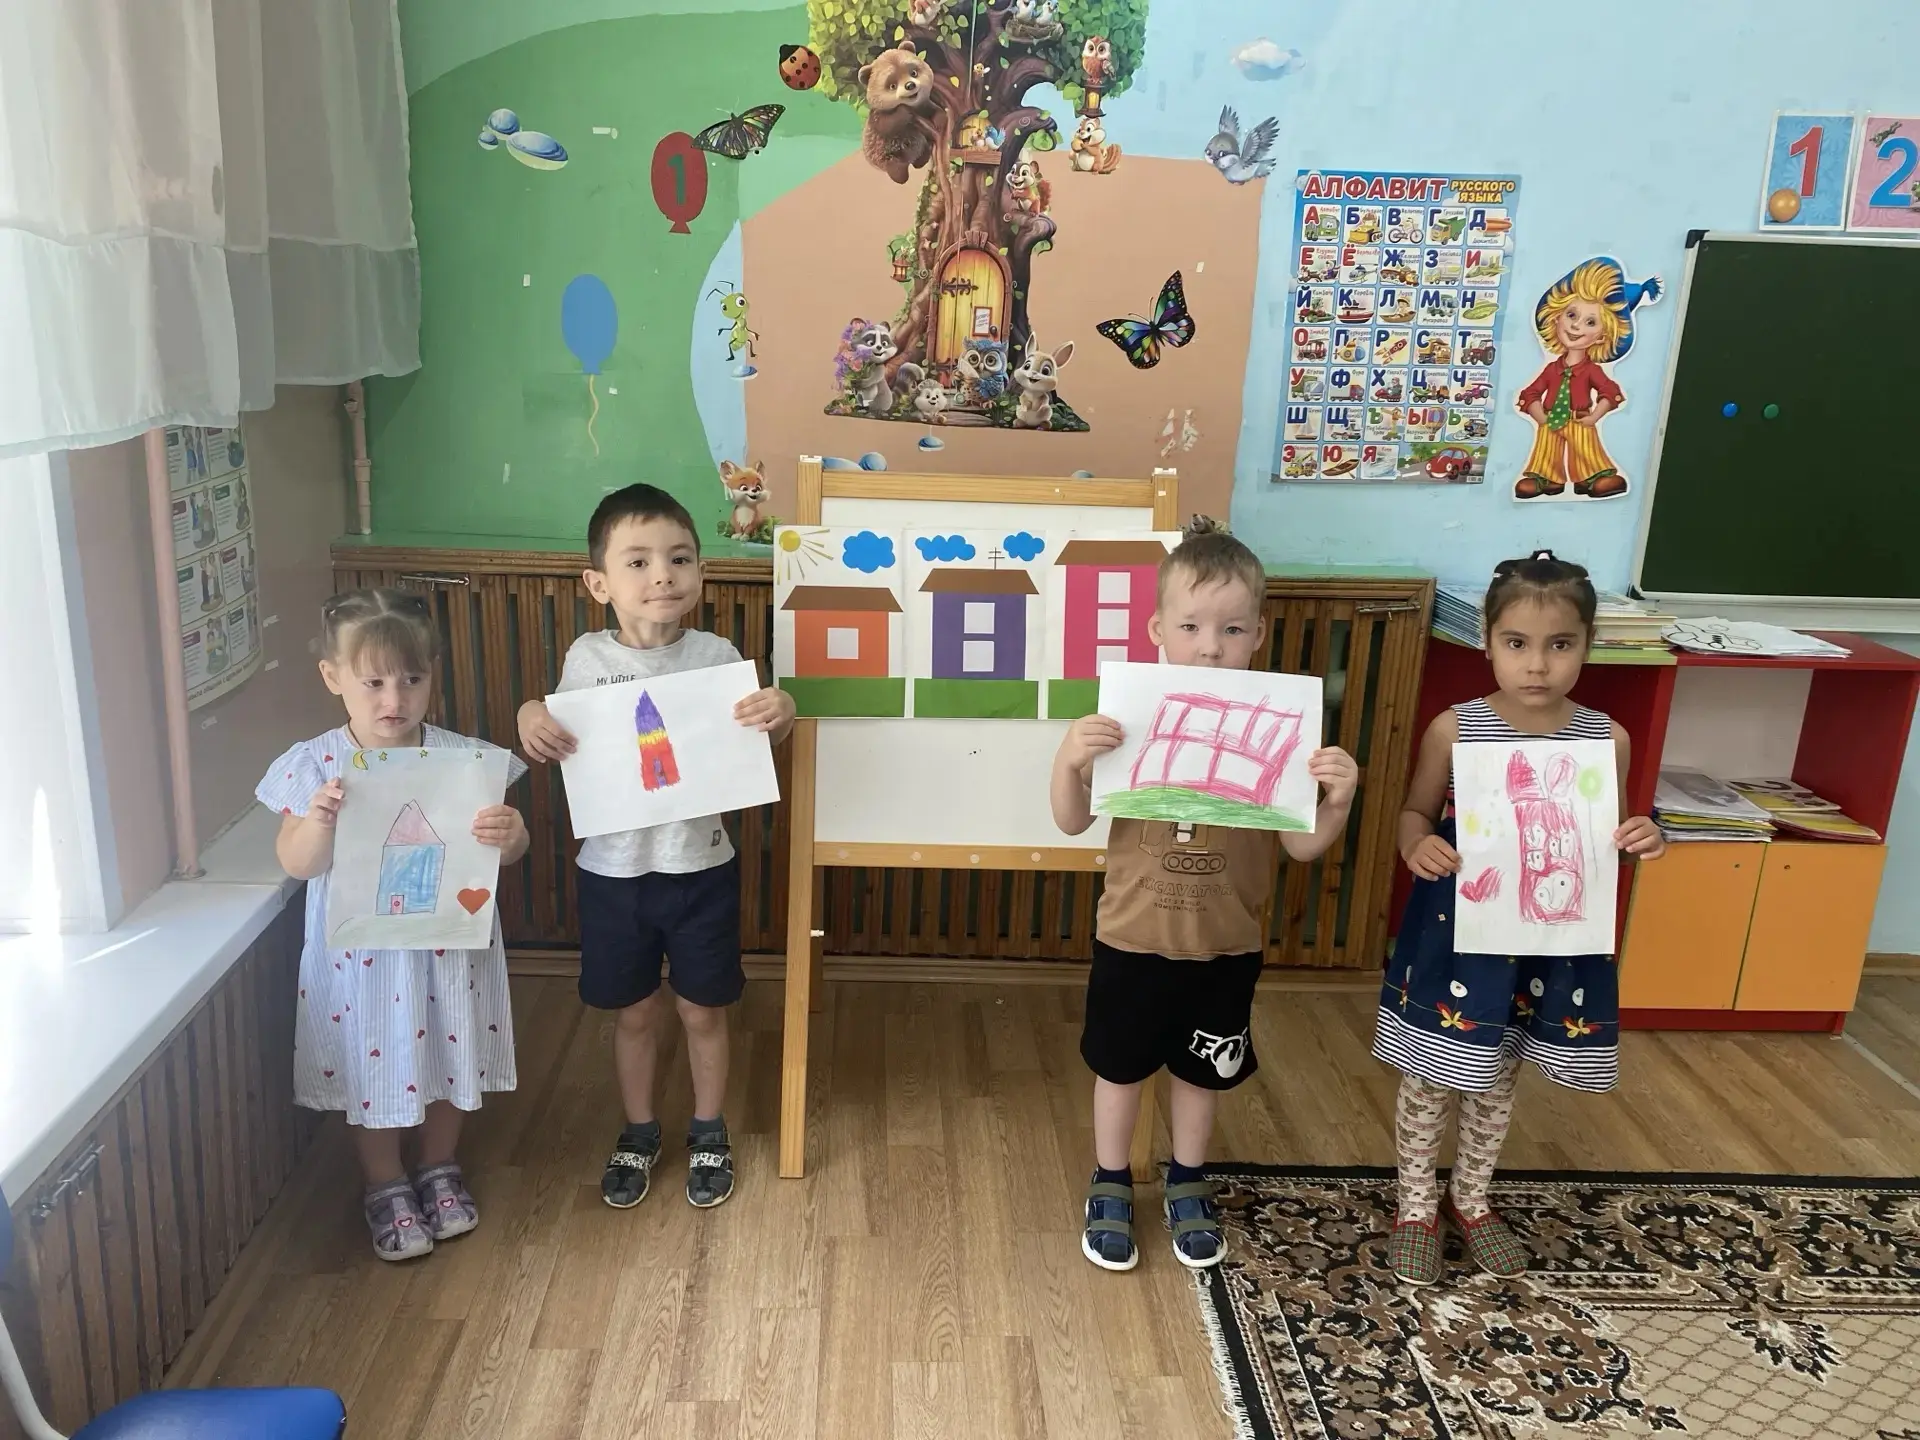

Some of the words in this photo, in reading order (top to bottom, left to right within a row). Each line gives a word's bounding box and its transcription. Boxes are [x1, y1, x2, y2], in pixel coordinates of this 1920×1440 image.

[1789, 125, 1824, 198] 1
[667, 153, 687, 205] 1
[1868, 136, 1919, 208] 2
[1303, 175, 1448, 201] АЛФАВИТ
[1451, 180, 1516, 192] РУССКОГО
[1459, 191, 1503, 203] ЯЗЫКА
[1304, 205, 1320, 225] А
[1346, 206, 1361, 225] Б
[1387, 207, 1402, 226] В
[1428, 208, 1442, 227] Г
[1469, 209, 1486, 231] Д
[1301, 247, 1315, 266] Е
[1342, 243, 1357, 267] Ё
[1383, 249, 1406, 267] Ж
[1425, 249, 1439, 268] З
[1466, 250, 1482, 269] И
[1296, 285, 1312, 308] Й
[1338, 288, 1353, 307] К
[1379, 289, 1396, 307] Л
[1420, 290, 1440, 308] М
[1461, 290, 1476, 309] Н
[1294, 327, 1309, 347] О
[1335, 329, 1349, 347] П
[1375, 329, 1390, 347] Р
[1416, 329, 1430, 348] С
[1458, 331, 1472, 348] Т
[1290, 367, 1305, 386] У
[1330, 368, 1351, 389] Ф
[1371, 369, 1386, 387] Х
[1412, 369, 1427, 390] Ц
[1453, 369, 1467, 388] Ч
[1287, 406, 1308, 424] Ш
[1326, 407, 1349, 428] Щ
[1368, 407, 1384, 425] Ъ
[1407, 408, 1428, 425] Ы
[1448, 408, 1462, 426] Ь
[1282, 445, 1296, 463] Э
[1322, 445, 1343, 463] Ю
[1362, 445, 1378, 463] Я
[596, 676, 608, 686] MY
[1135, 876, 1232, 898] EXCAVATOR
